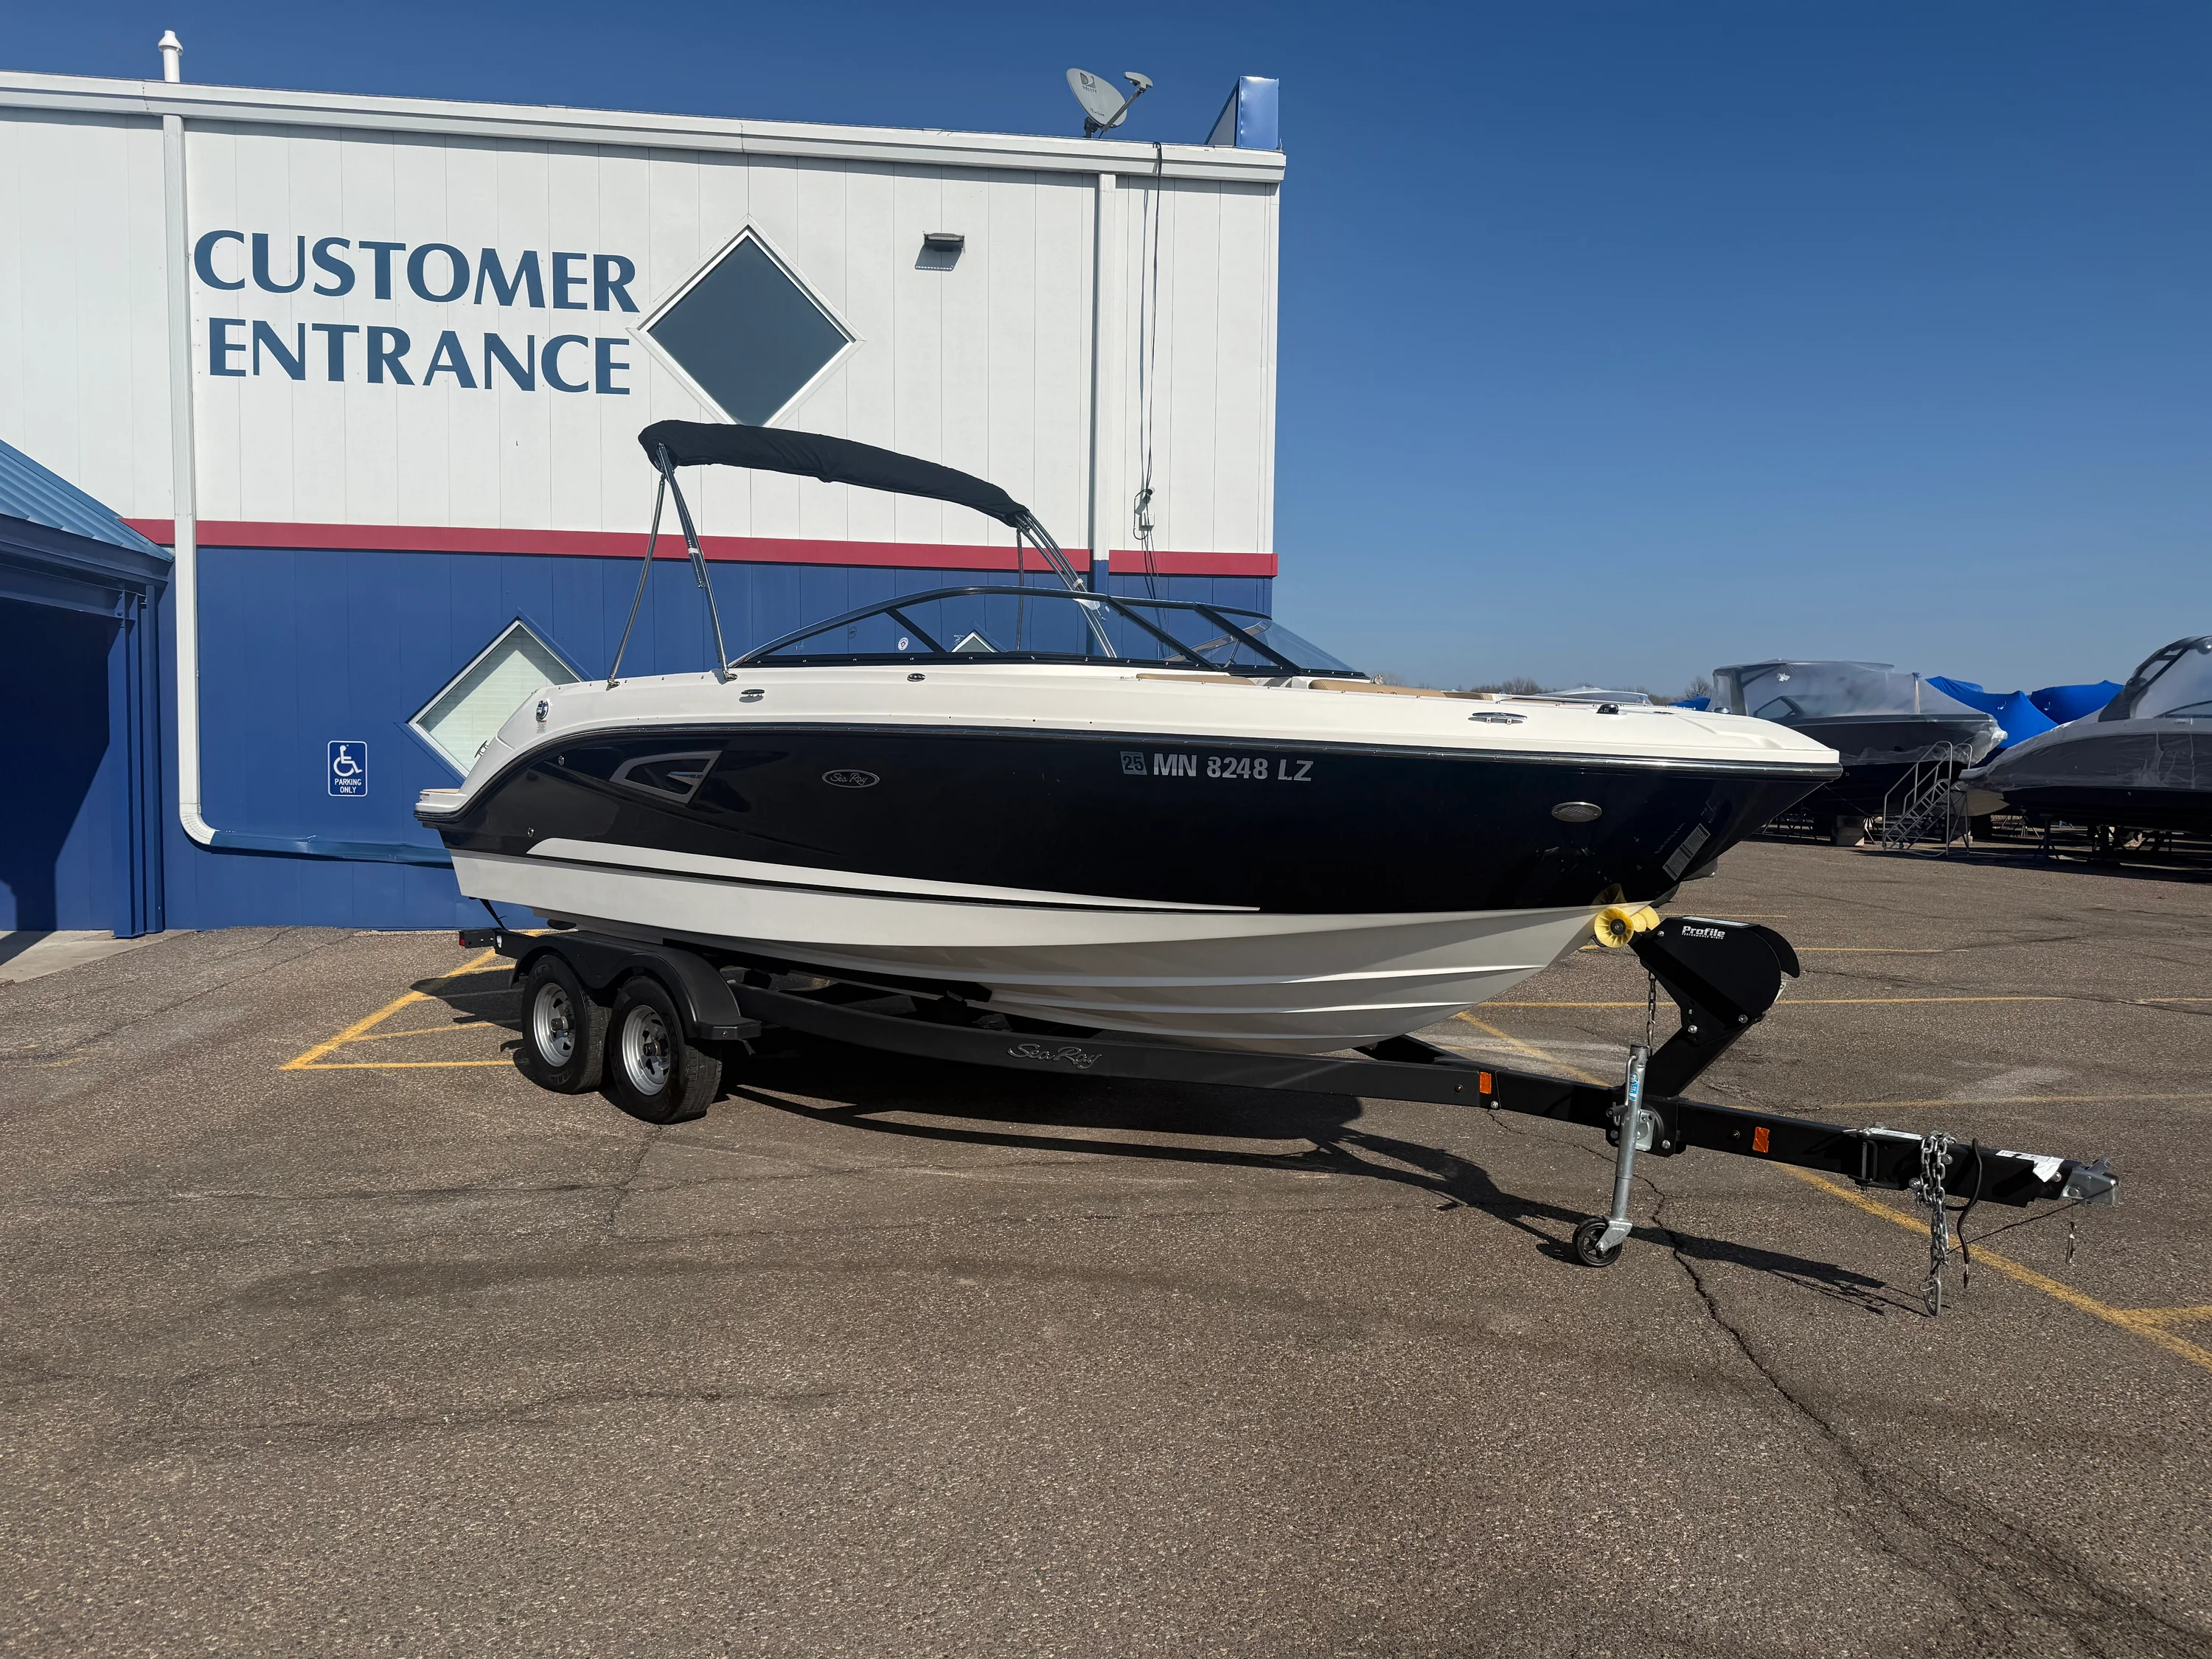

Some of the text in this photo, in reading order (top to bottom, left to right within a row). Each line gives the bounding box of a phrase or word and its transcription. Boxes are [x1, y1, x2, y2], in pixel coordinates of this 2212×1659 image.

[194, 229, 639, 313] CUSTOMER
[209, 317, 630, 395] ENTRANCE
[1122, 755, 1144, 771] 25
[1153, 753, 1314, 782] MN 8248 LZ
[334, 778, 362, 786] PARKING
[1681, 925, 1725, 937] Profile
